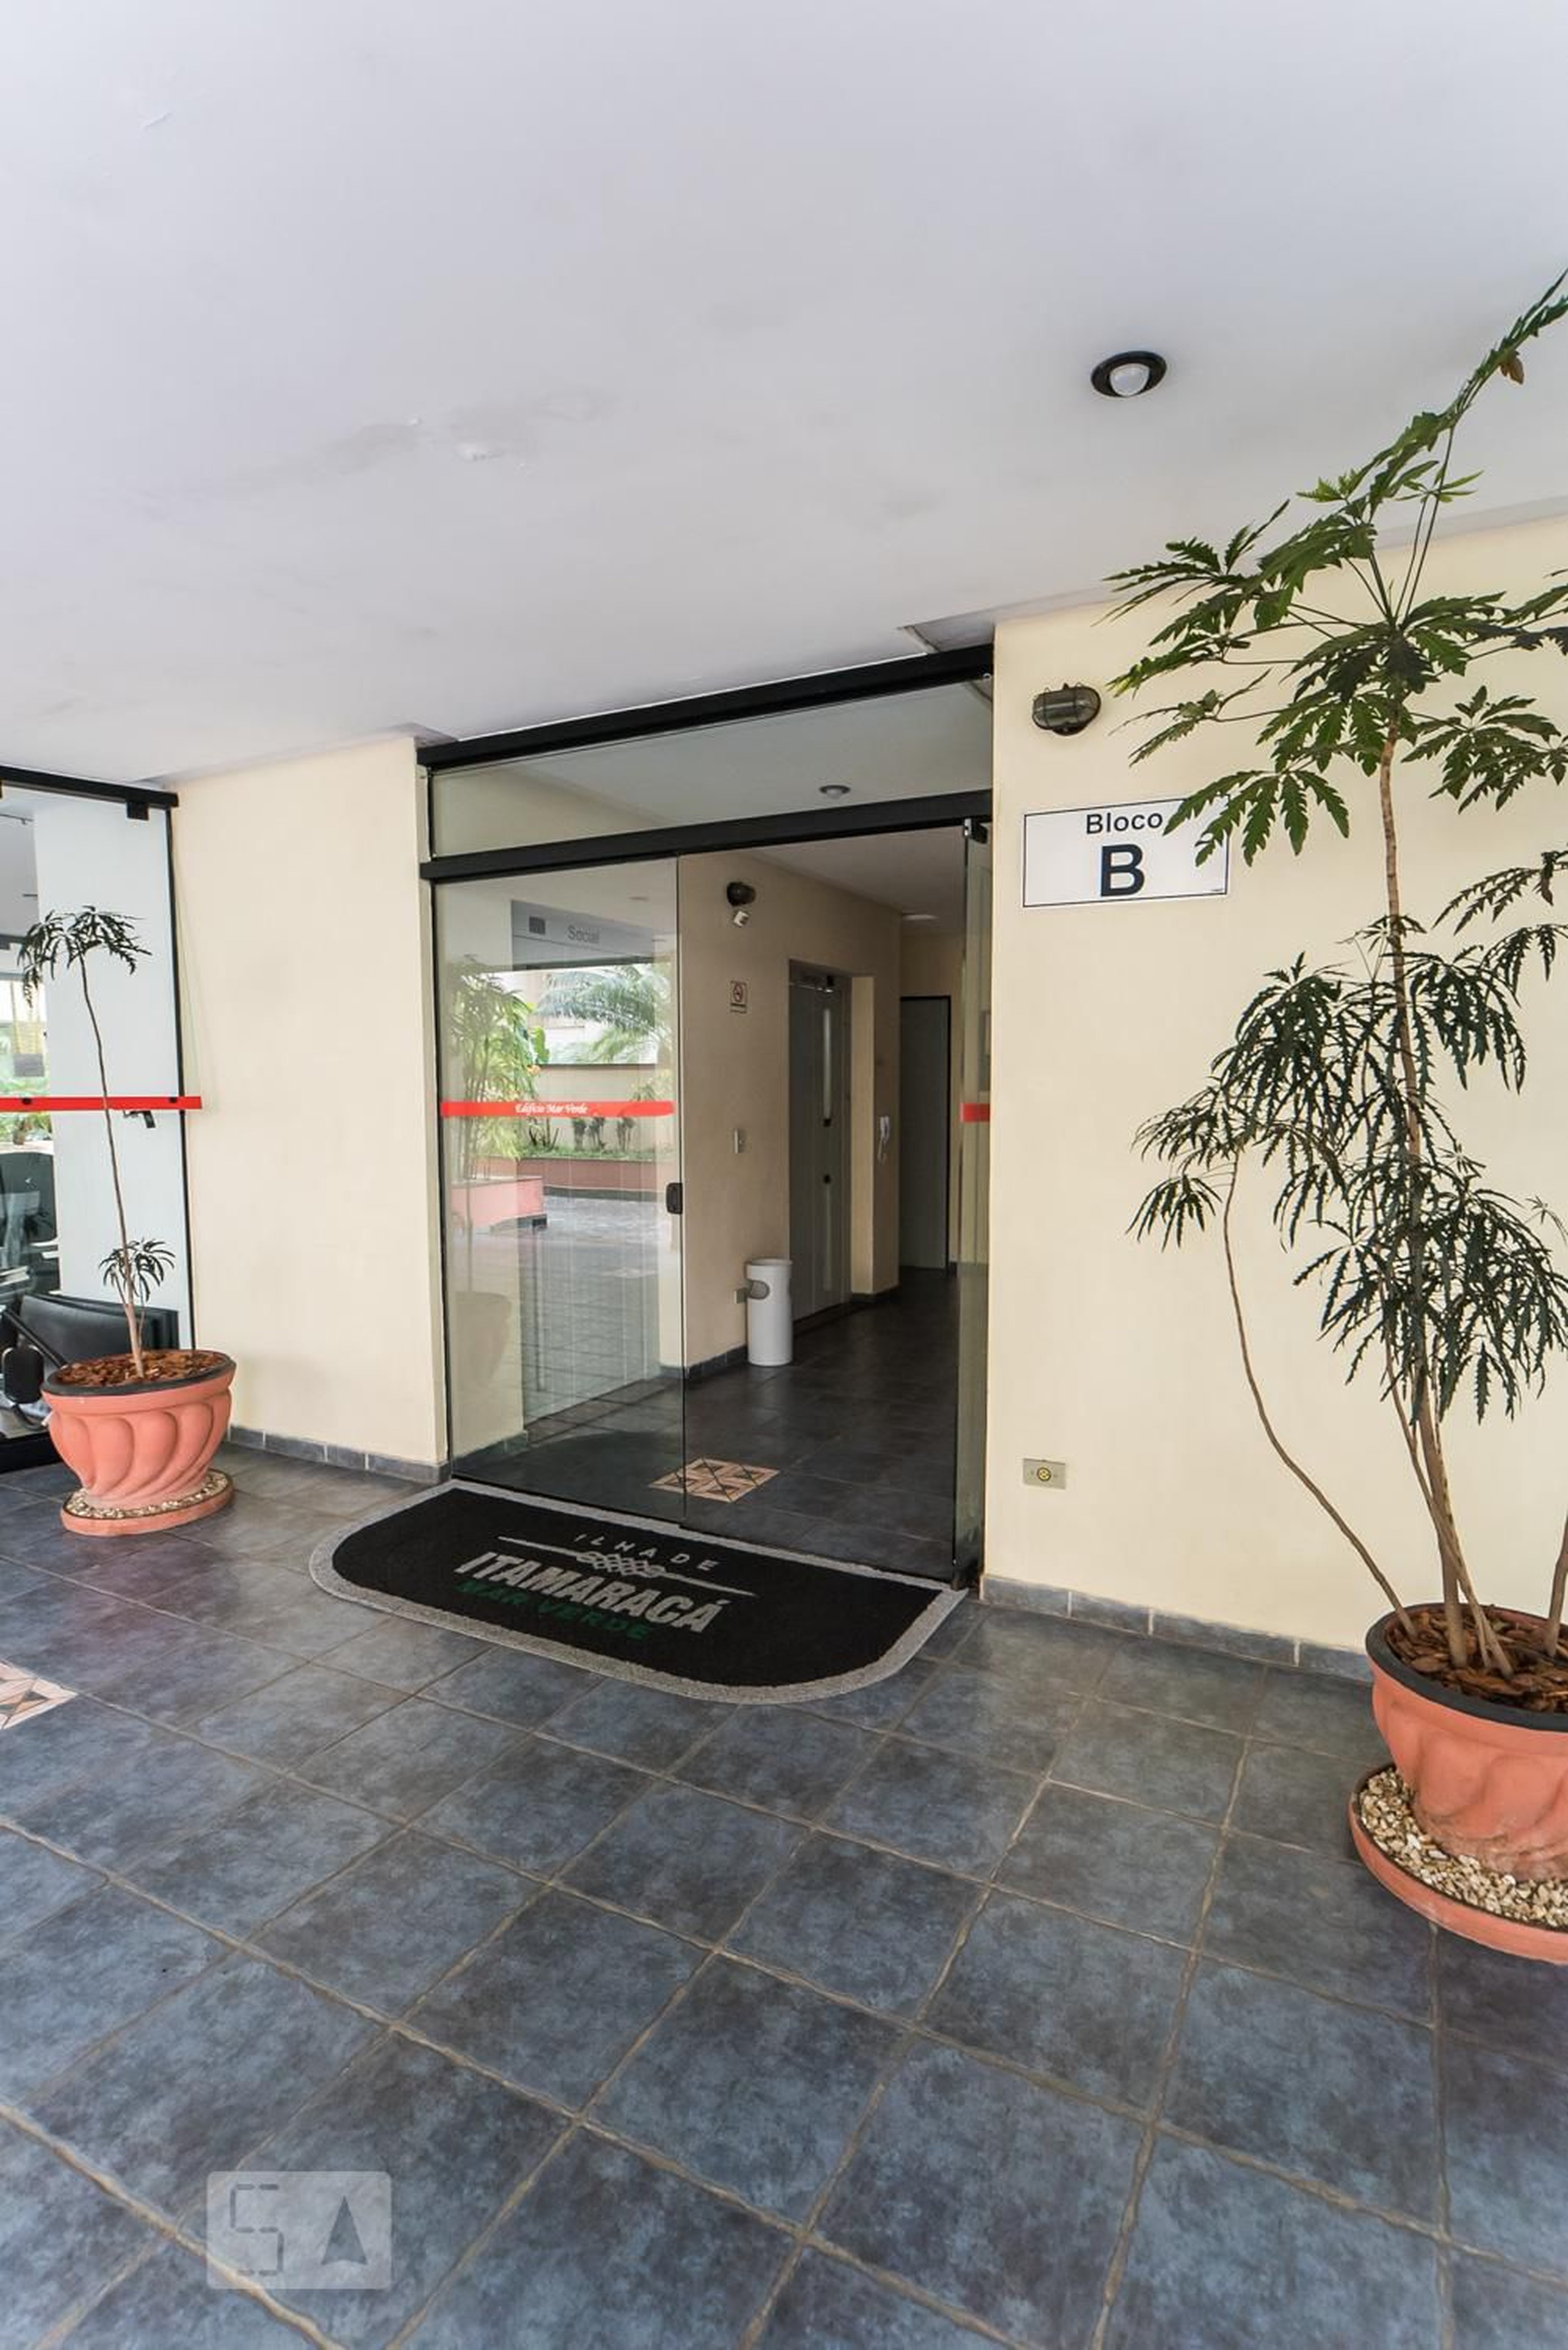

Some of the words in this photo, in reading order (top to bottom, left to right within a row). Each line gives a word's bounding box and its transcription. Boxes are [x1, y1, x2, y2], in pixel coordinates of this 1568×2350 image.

[1086, 812, 1163, 834] Bloco
[1100, 843, 1144, 897] B
[574, 1534, 657, 1558] ILHA
[670, 1553, 719, 1571] DE
[453, 1552, 733, 1633] ITAMARACÁ
